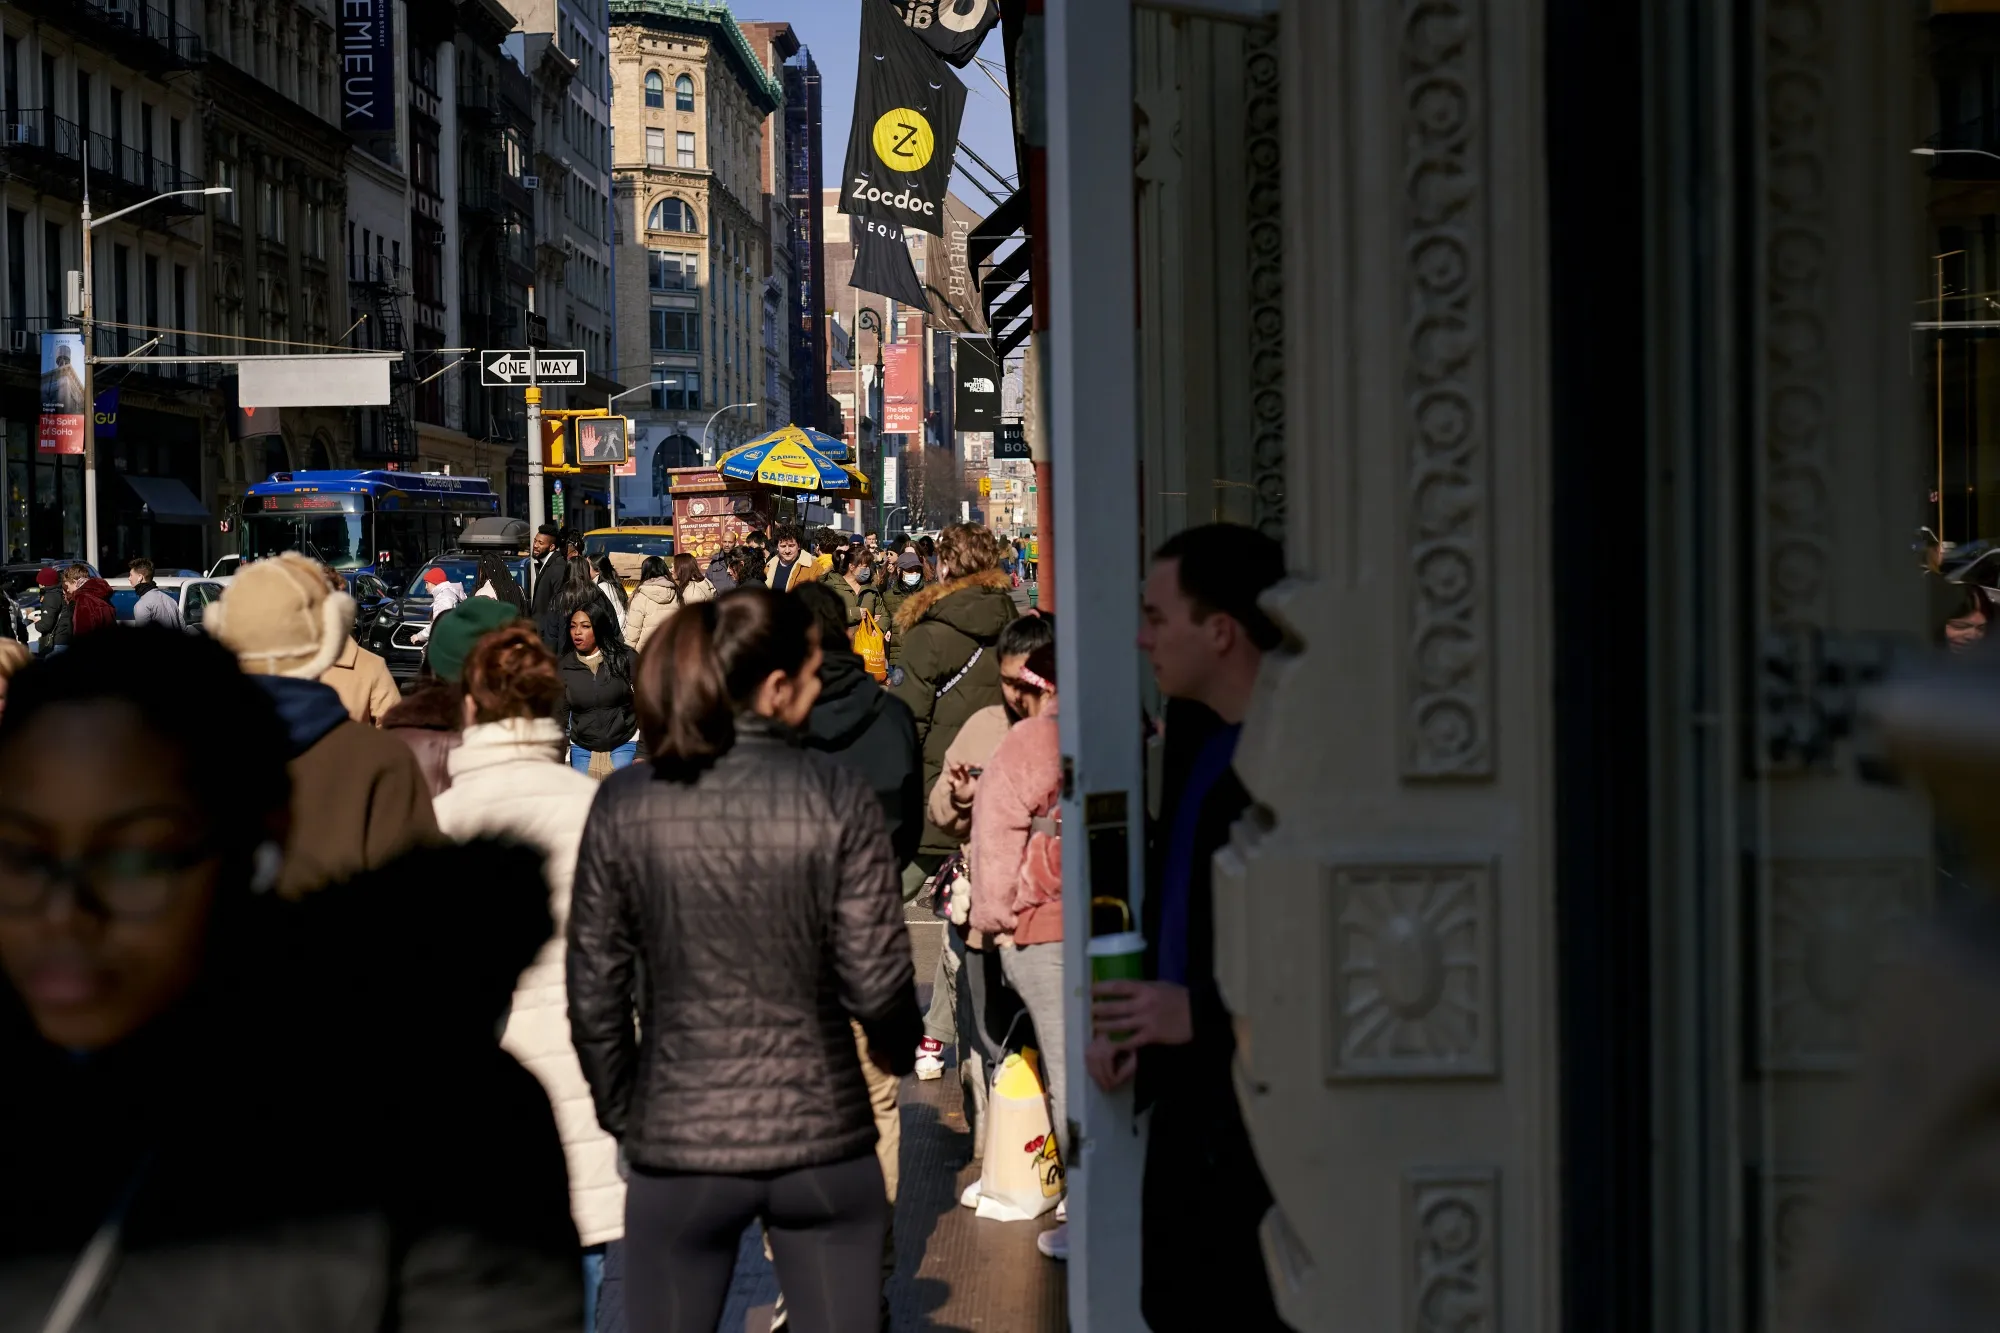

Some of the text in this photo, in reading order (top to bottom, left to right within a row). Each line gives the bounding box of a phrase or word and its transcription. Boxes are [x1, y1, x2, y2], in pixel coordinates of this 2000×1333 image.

[852, 178, 935, 216] Zocdoc
[948, 220, 969, 296] FOREVER
[498, 361, 571, 375] ONE WAY
[897, 406, 913, 414] Spirit
[42, 417, 78, 428] The Spirit
[42, 428, 73, 436] of SoHo
[760, 471, 816, 486] SABRETT
[942, 647, 984, 693] adidas adidas
[924, 1041, 938, 1050] NIKE
